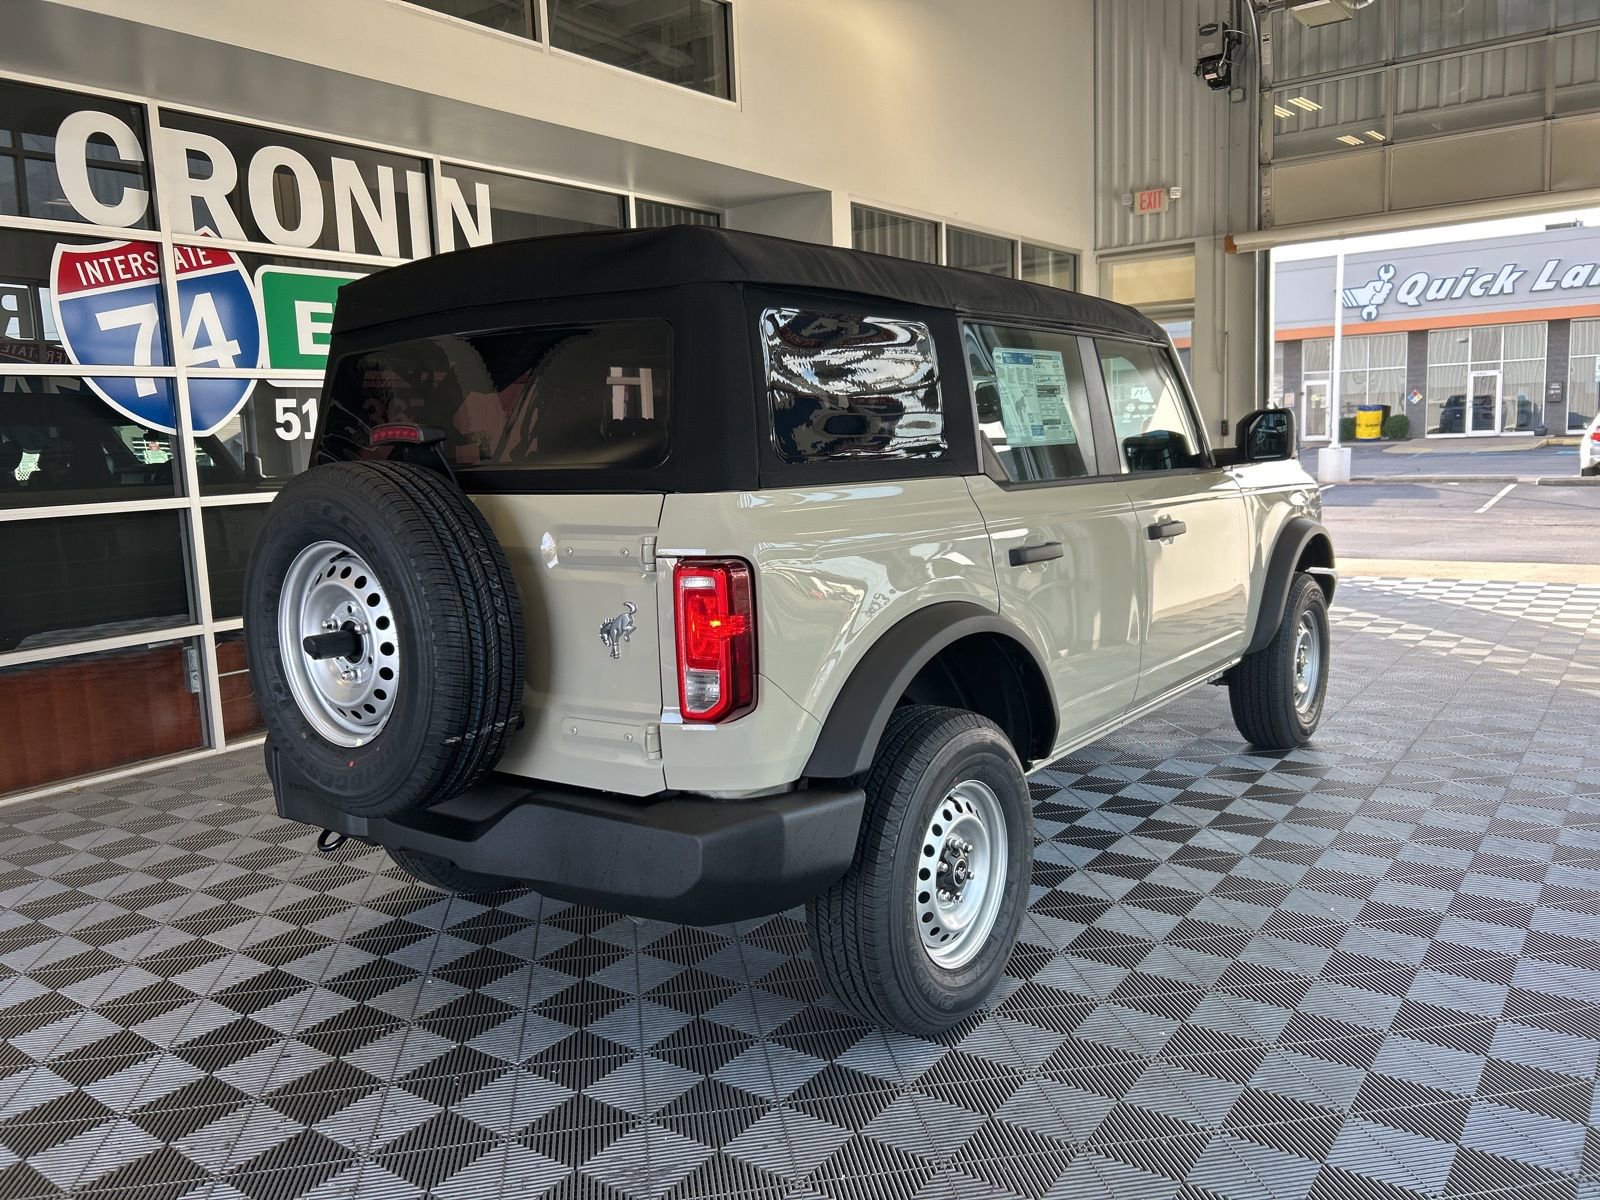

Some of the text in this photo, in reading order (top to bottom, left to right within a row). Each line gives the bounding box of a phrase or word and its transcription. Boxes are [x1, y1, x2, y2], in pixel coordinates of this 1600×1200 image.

[55, 110, 494, 260] CRONIN
[1139, 189, 1163, 211] EXIT
[75, 246, 213, 286] INTERSATE
[1396, 263, 1527, 307] Quick
[95, 292, 242, 398] 74
[294, 300, 337, 356] E
